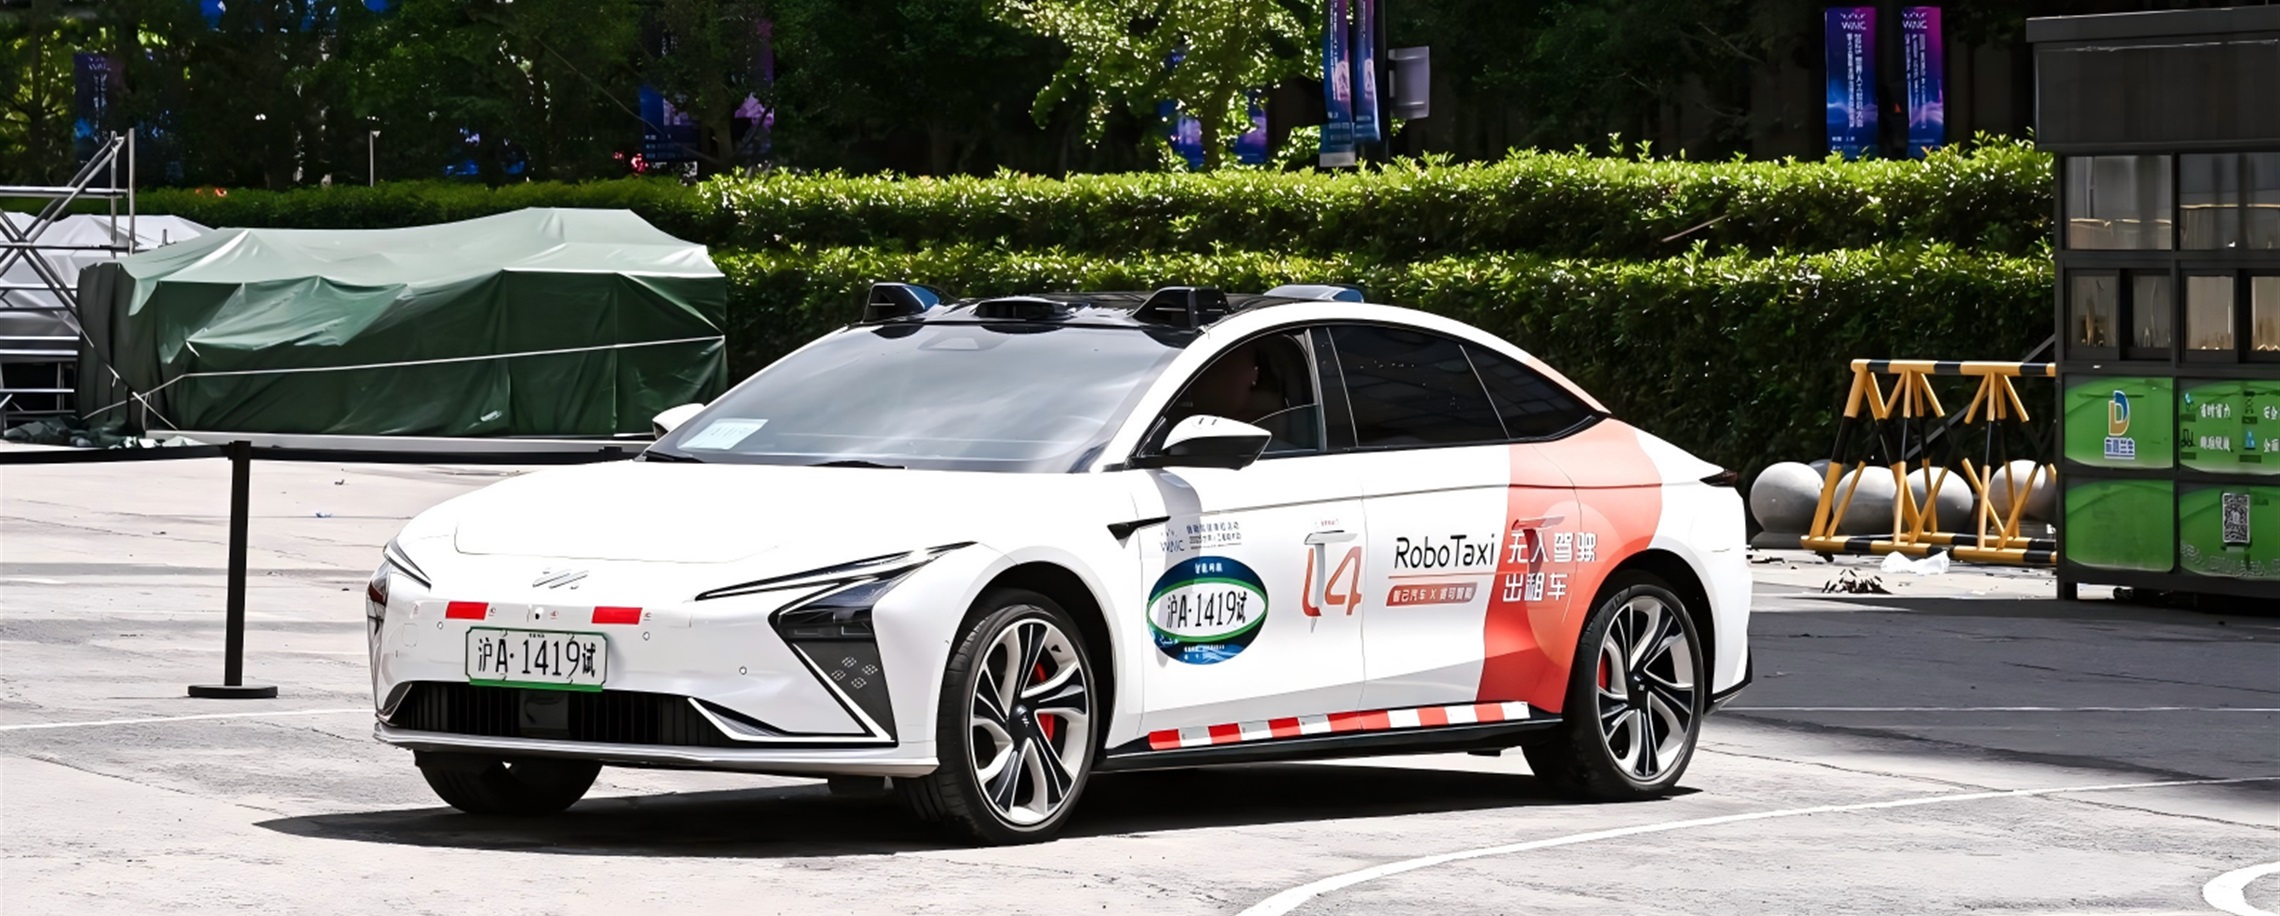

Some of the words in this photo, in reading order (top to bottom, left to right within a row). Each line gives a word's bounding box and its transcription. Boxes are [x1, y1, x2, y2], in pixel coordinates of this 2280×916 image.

[1394, 534, 1495, 569] RoboTaxi
[1507, 532, 1597, 564] 无人驾驶
[1503, 572, 1569, 603] 出租车
